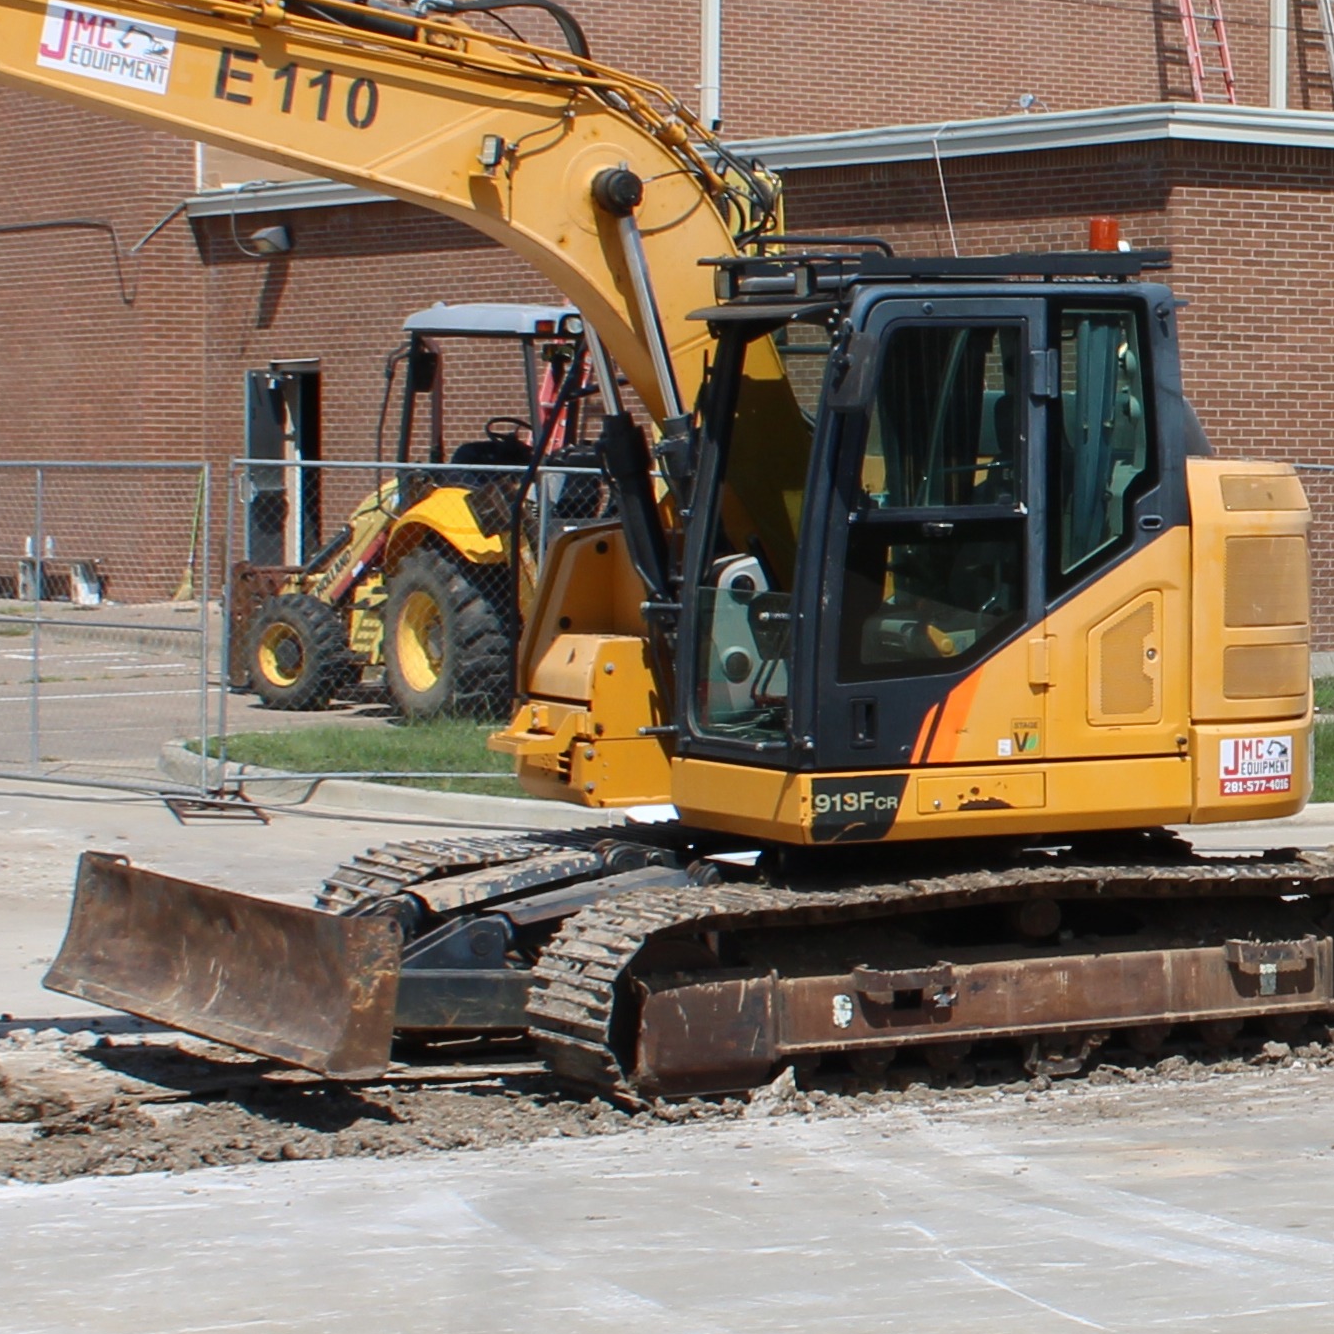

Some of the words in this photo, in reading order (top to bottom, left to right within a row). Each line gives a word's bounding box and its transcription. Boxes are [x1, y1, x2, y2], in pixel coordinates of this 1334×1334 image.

[39, 9, 116, 61] JMC
[68, 43, 169, 85] EQUIPMENT
[1223, 739, 1264, 776] JMC
[1240, 759, 1289, 776] EQUIPMENT
